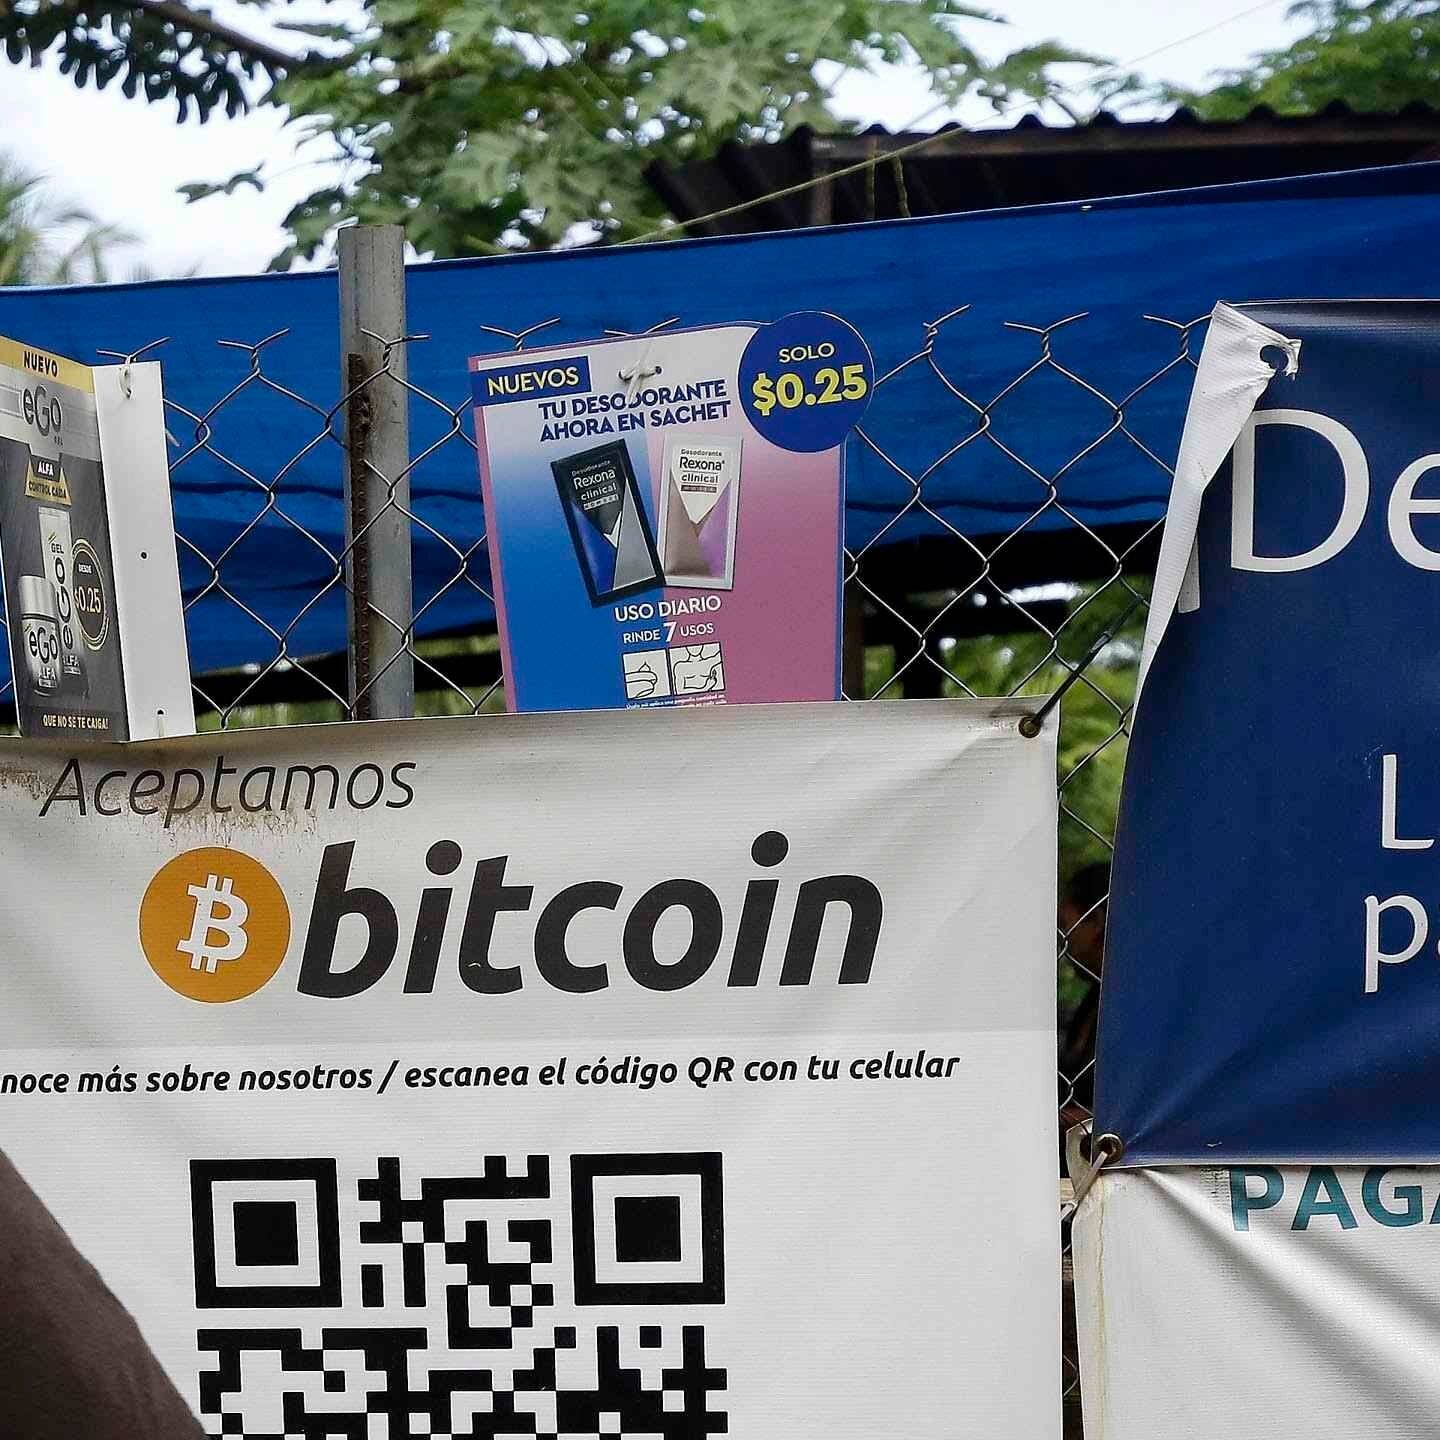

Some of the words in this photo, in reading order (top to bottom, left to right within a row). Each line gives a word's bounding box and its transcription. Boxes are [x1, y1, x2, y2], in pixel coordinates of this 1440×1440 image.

[23, 350, 58, 378] NUEVO
[778, 342, 835, 363] SOLO
[486, 366, 579, 396] NUEVOS
[751, 364, 868, 416] $0.25
[538, 399, 567, 420] TU
[571, 378, 728, 415] DESODORANTE
[539, 415, 615, 442] AHORA
[618, 413, 646, 433] EN
[650, 400, 732, 429] SACHET
[679, 456, 725, 471] Rexona
[573, 468, 616, 490] Rexona
[580, 483, 617, 501] clinical
[681, 473, 719, 484] clinical
[615, 601, 655, 622] USO
[659, 596, 722, 618] DIARIO
[29, 627, 59, 664] eGo
[623, 629, 661, 644] RINDE
[664, 622, 678, 642] 7
[680, 623, 714, 638] USOS
[42, 714, 57, 727] QUE
[57, 716, 68, 728] NO
[39, 758, 418, 829] Aceptamos
[297, 830, 886, 1000] bitcoin
[77, 1066, 136, 1092] más
[146, 1065, 229, 1092] sobre
[238, 1062, 374, 1092] nosotros
[377, 1062, 398, 1092] /
[405, 1063, 528, 1087] escanea
[538, 1058, 566, 1086] el
[575, 1054, 677, 1090] código
[687, 1056, 734, 1086] QR
[743, 1059, 798, 1082] con
[806, 1055, 840, 1081] tu
[849, 1050, 958, 1079] celular
